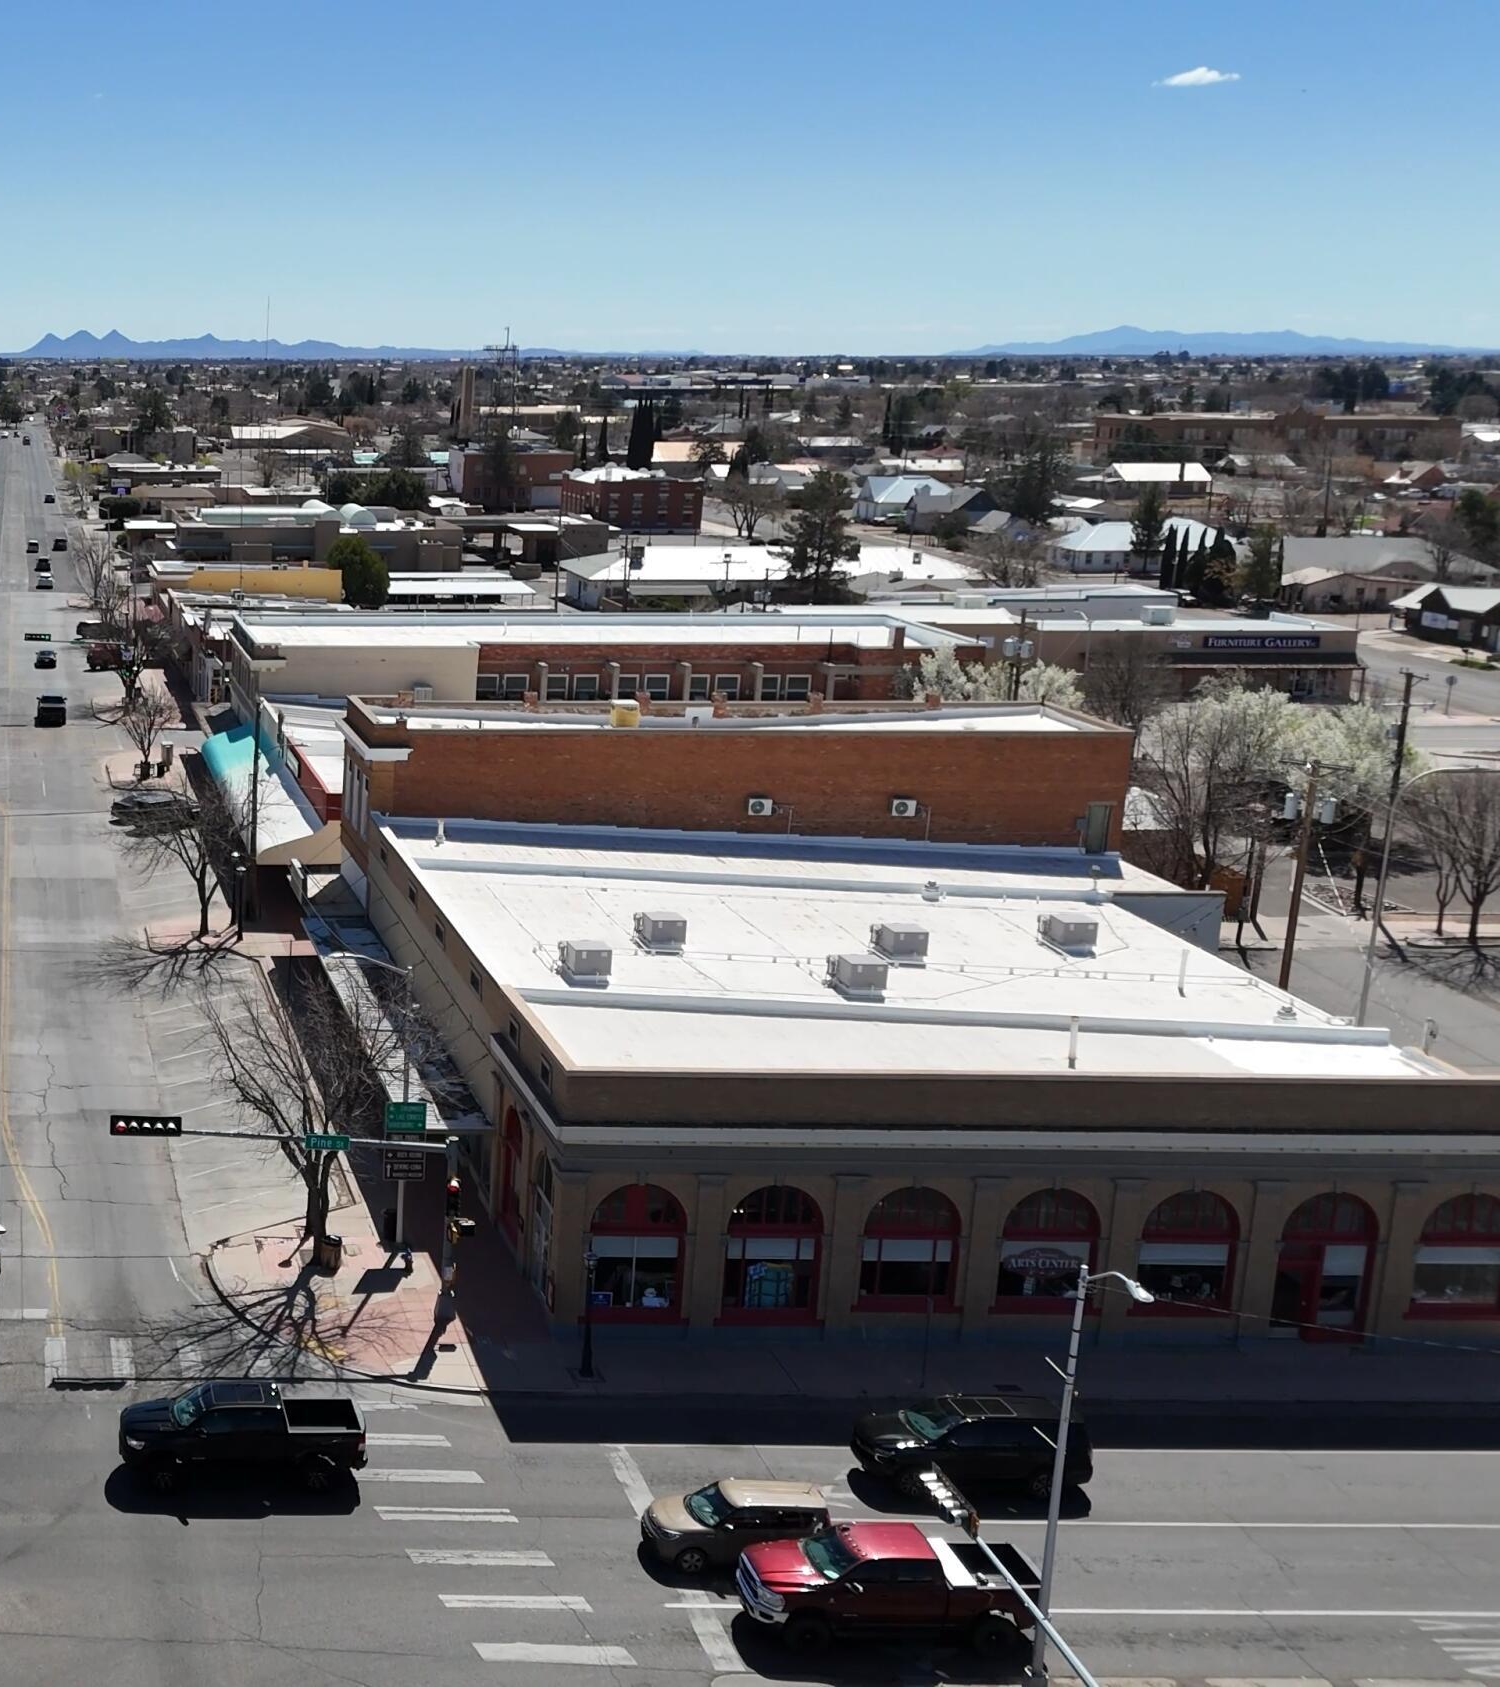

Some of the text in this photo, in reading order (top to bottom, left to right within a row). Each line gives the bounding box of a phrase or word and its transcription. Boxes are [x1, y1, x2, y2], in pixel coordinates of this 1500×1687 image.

[1208, 637, 1311, 647] FURNITURE GALLERY
[311, 1137, 333, 1148] Pine
[1008, 1258, 1078, 1269] ARTS CENTER
